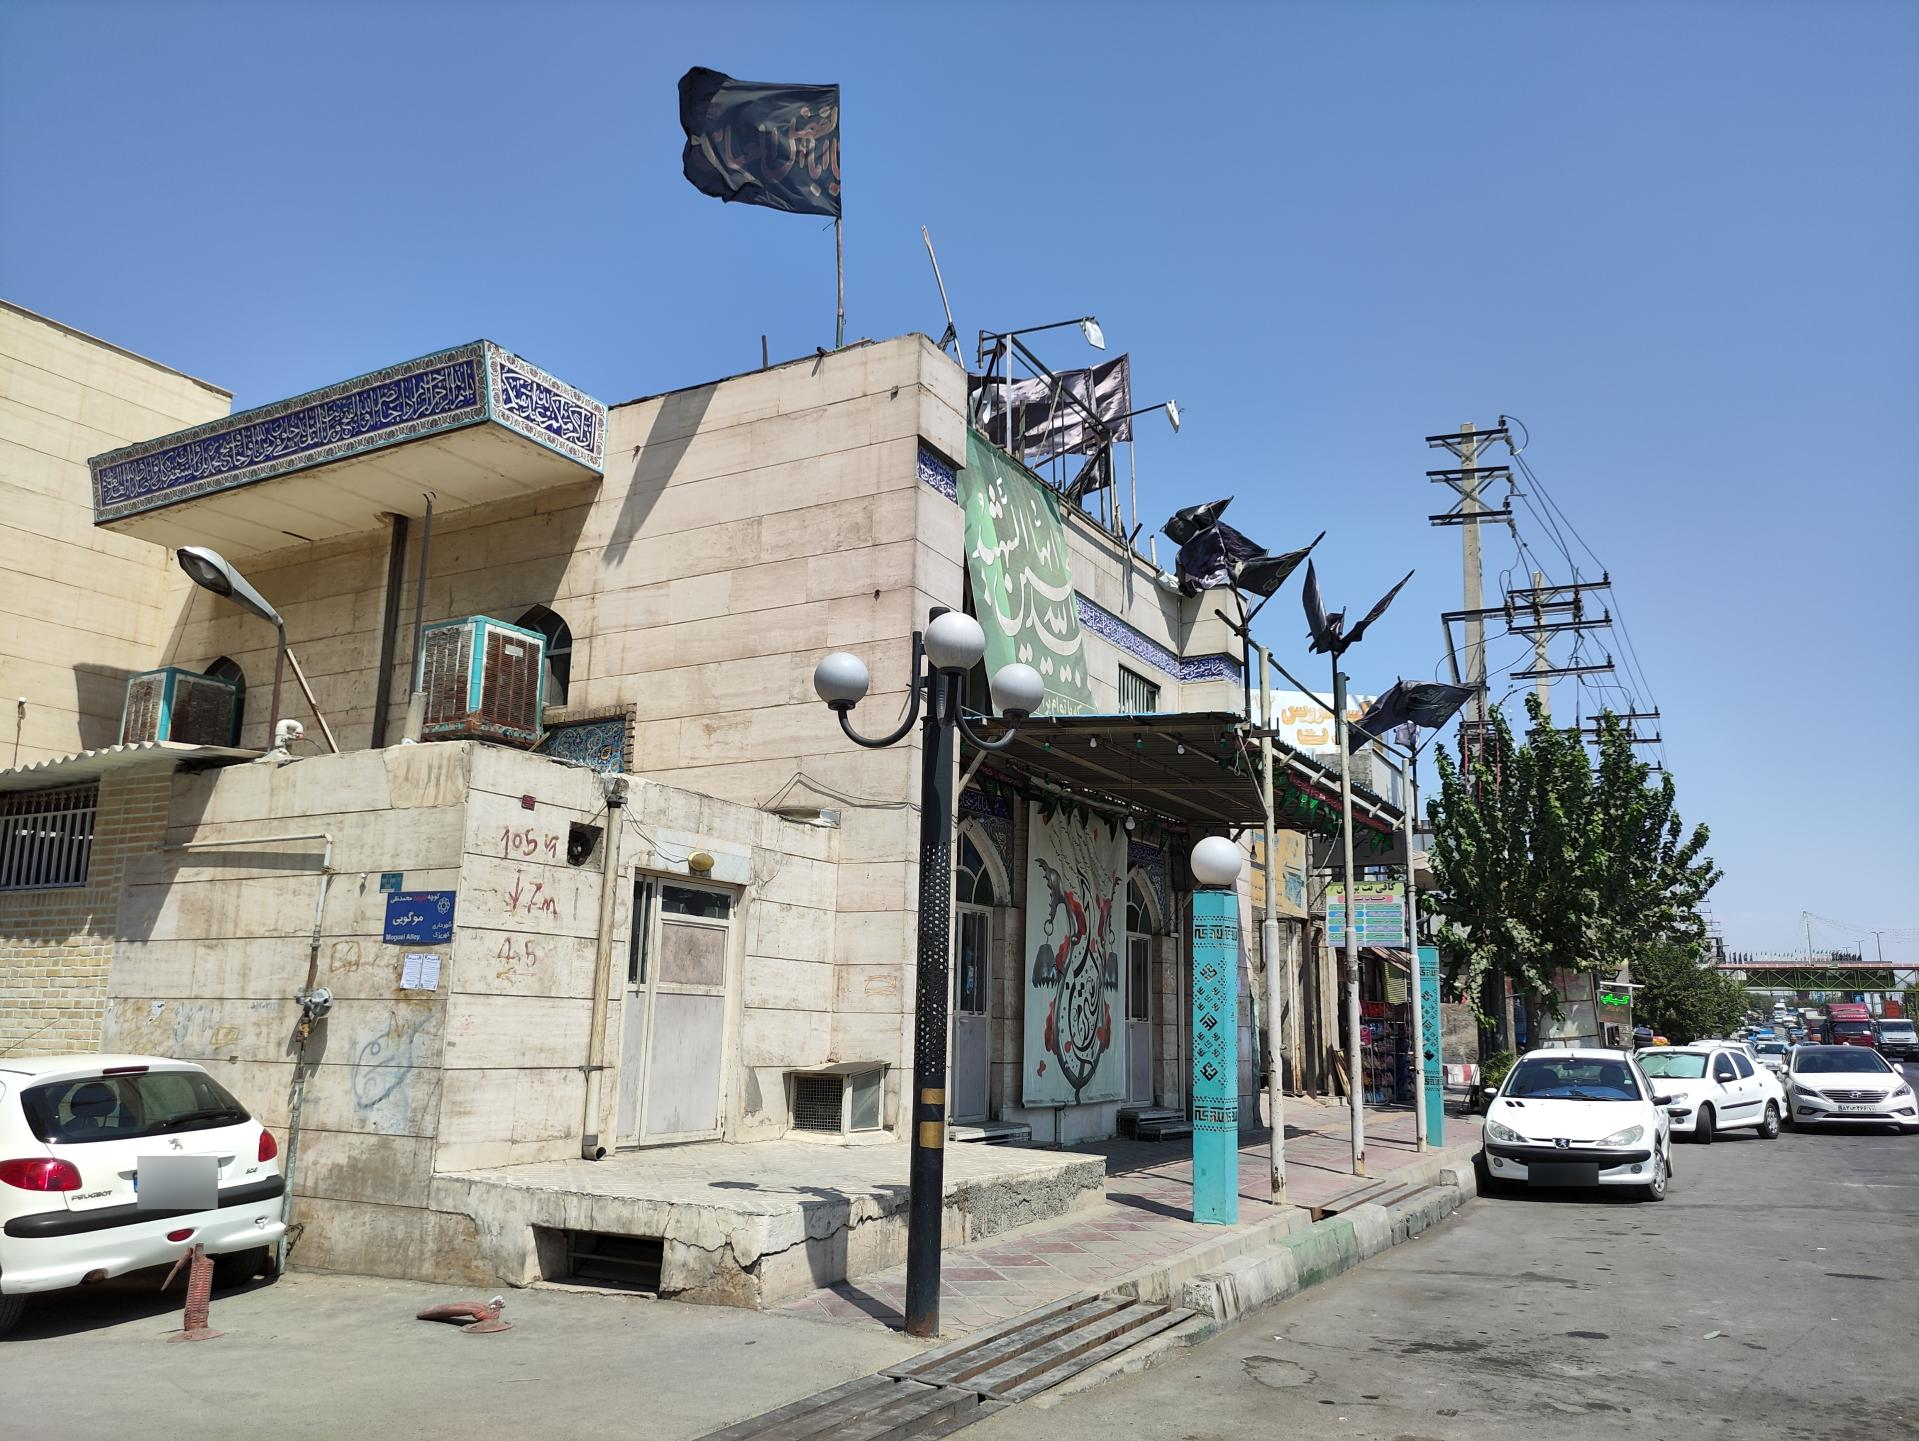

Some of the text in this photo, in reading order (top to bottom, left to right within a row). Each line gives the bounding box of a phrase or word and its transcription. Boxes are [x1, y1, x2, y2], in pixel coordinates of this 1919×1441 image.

[427, 892, 440, 901] کوچه
[392, 911, 423, 926] موگویی
[431, 920, 452, 930] شهرداری
[432, 931, 450, 939] کهریزک
[71, 1190, 113, 1201] PEUGEOT
